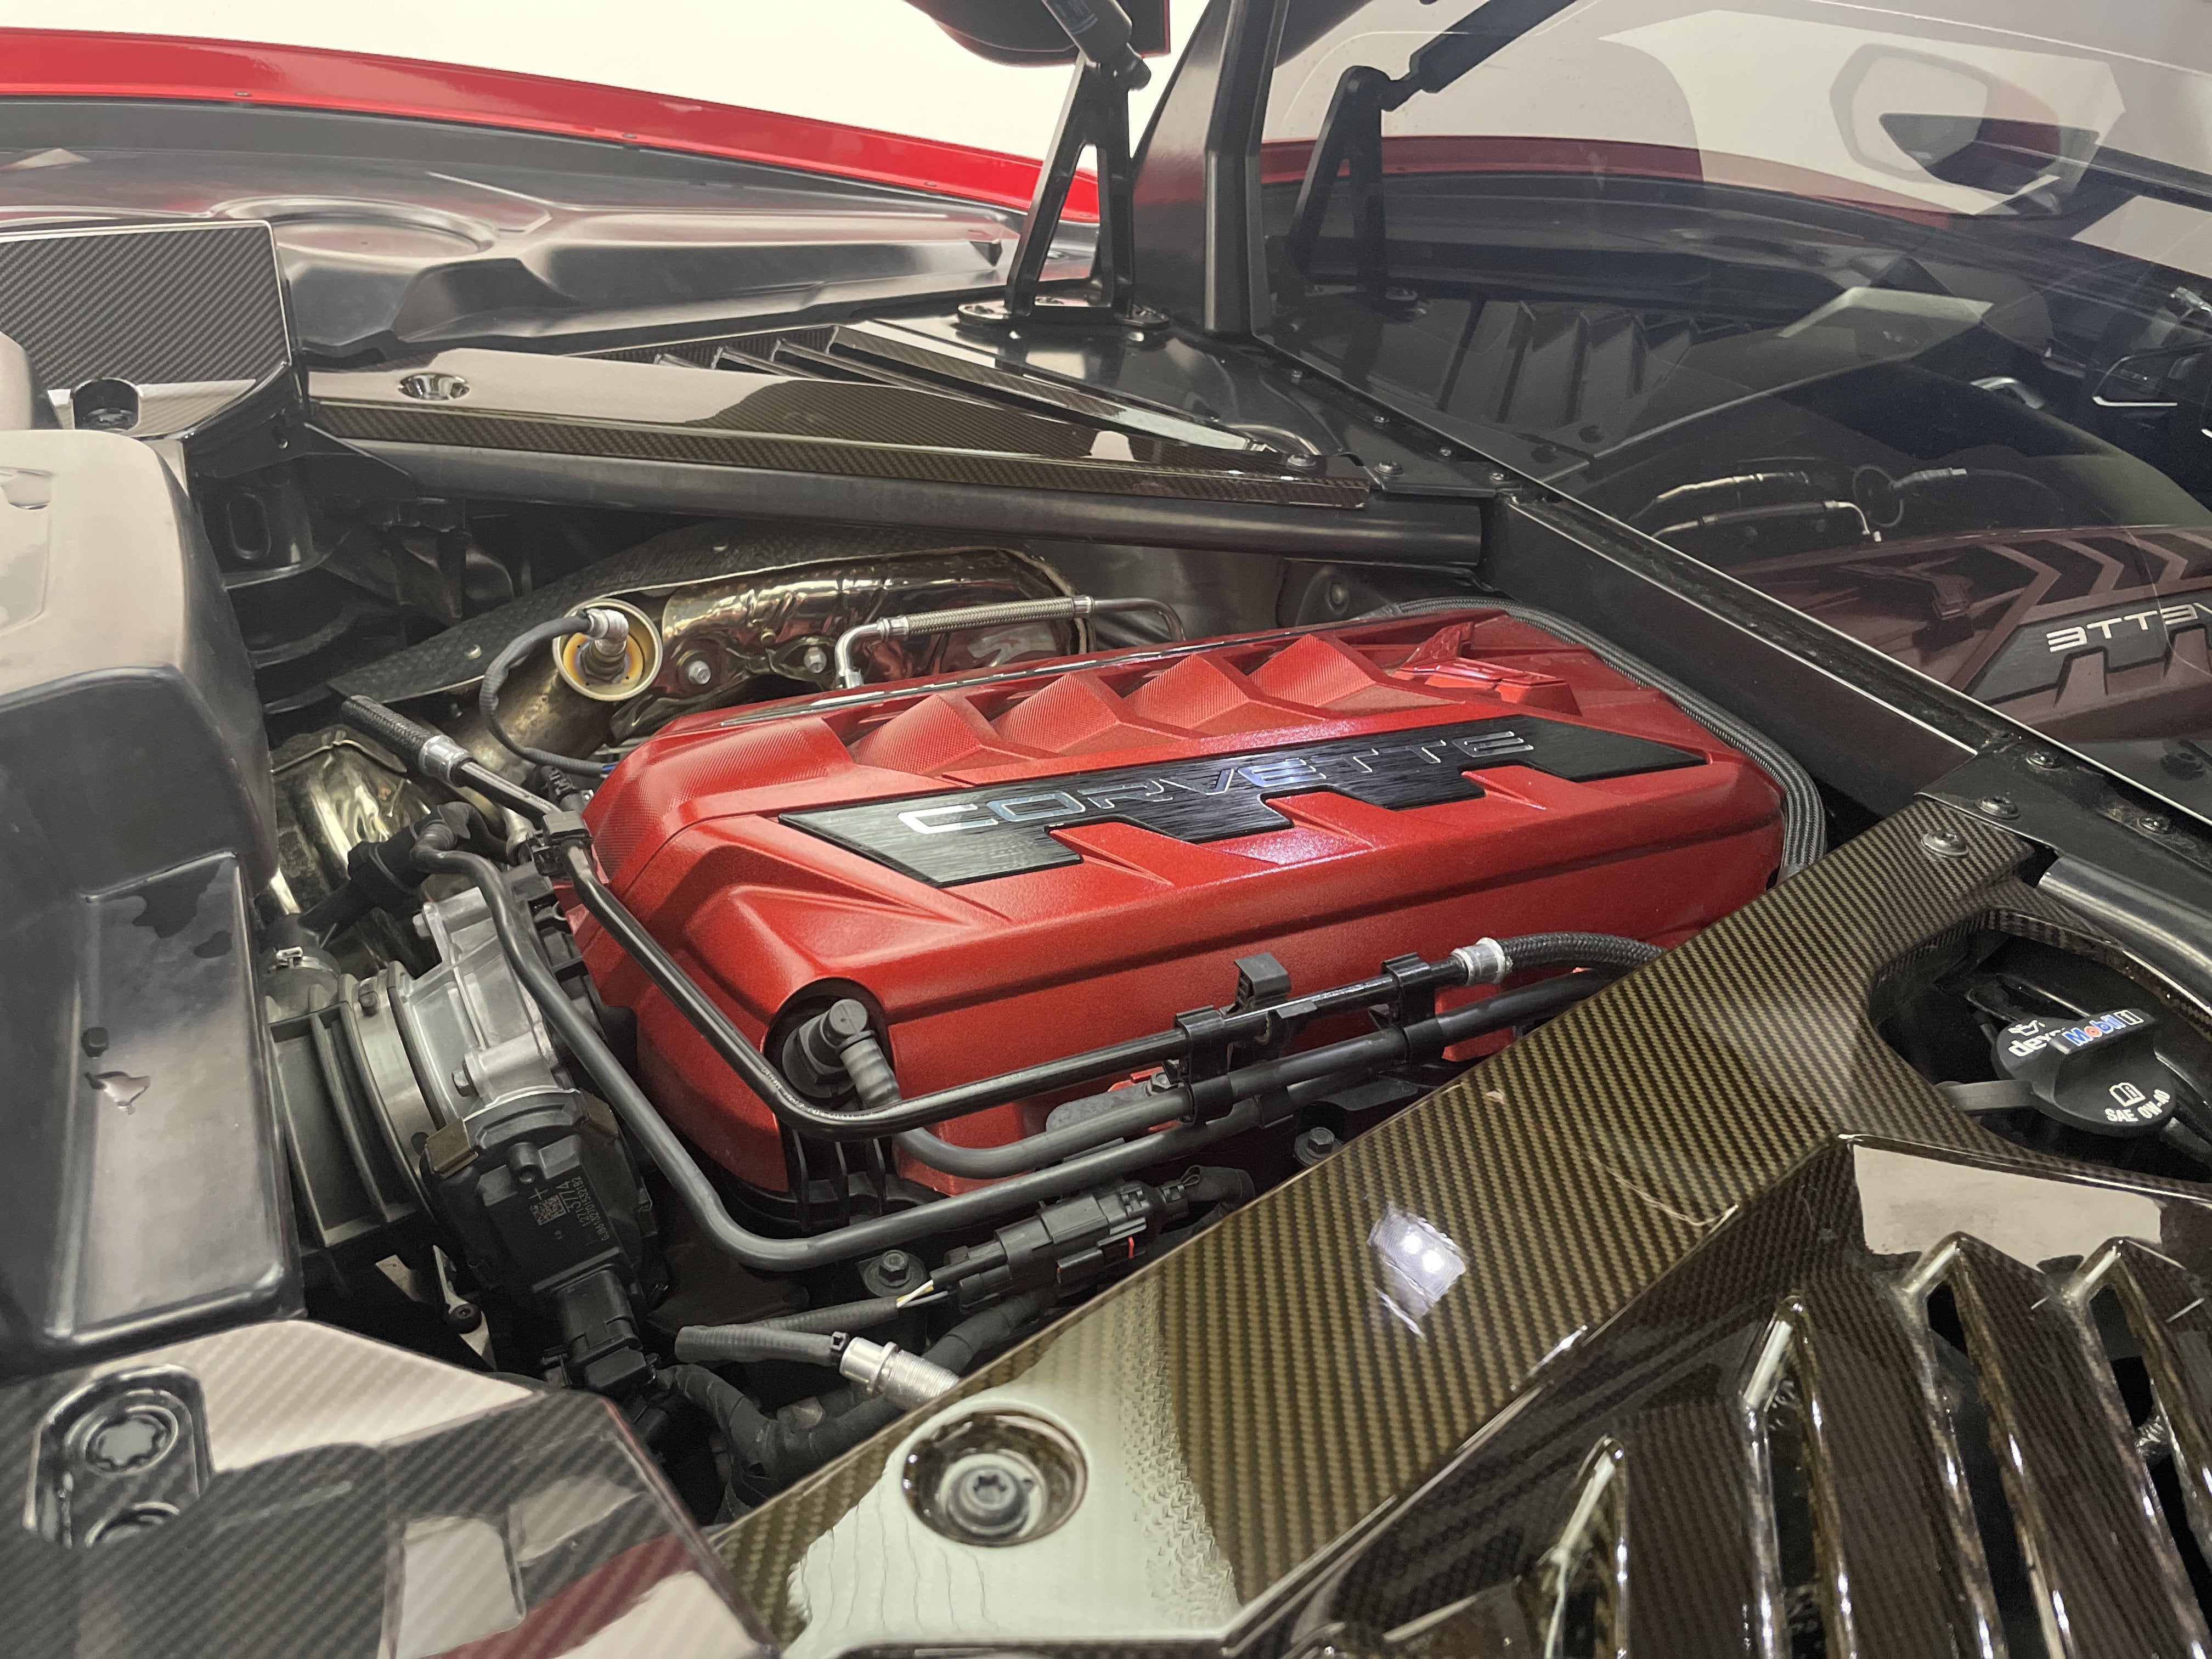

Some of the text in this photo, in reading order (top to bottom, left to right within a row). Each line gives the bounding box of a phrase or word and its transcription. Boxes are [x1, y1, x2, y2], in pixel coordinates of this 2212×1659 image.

[897, 731, 1534, 834] CORVETTE
[2062, 1014, 2126, 1046] Mobil
[2105, 1108, 2138, 1122] SAE
